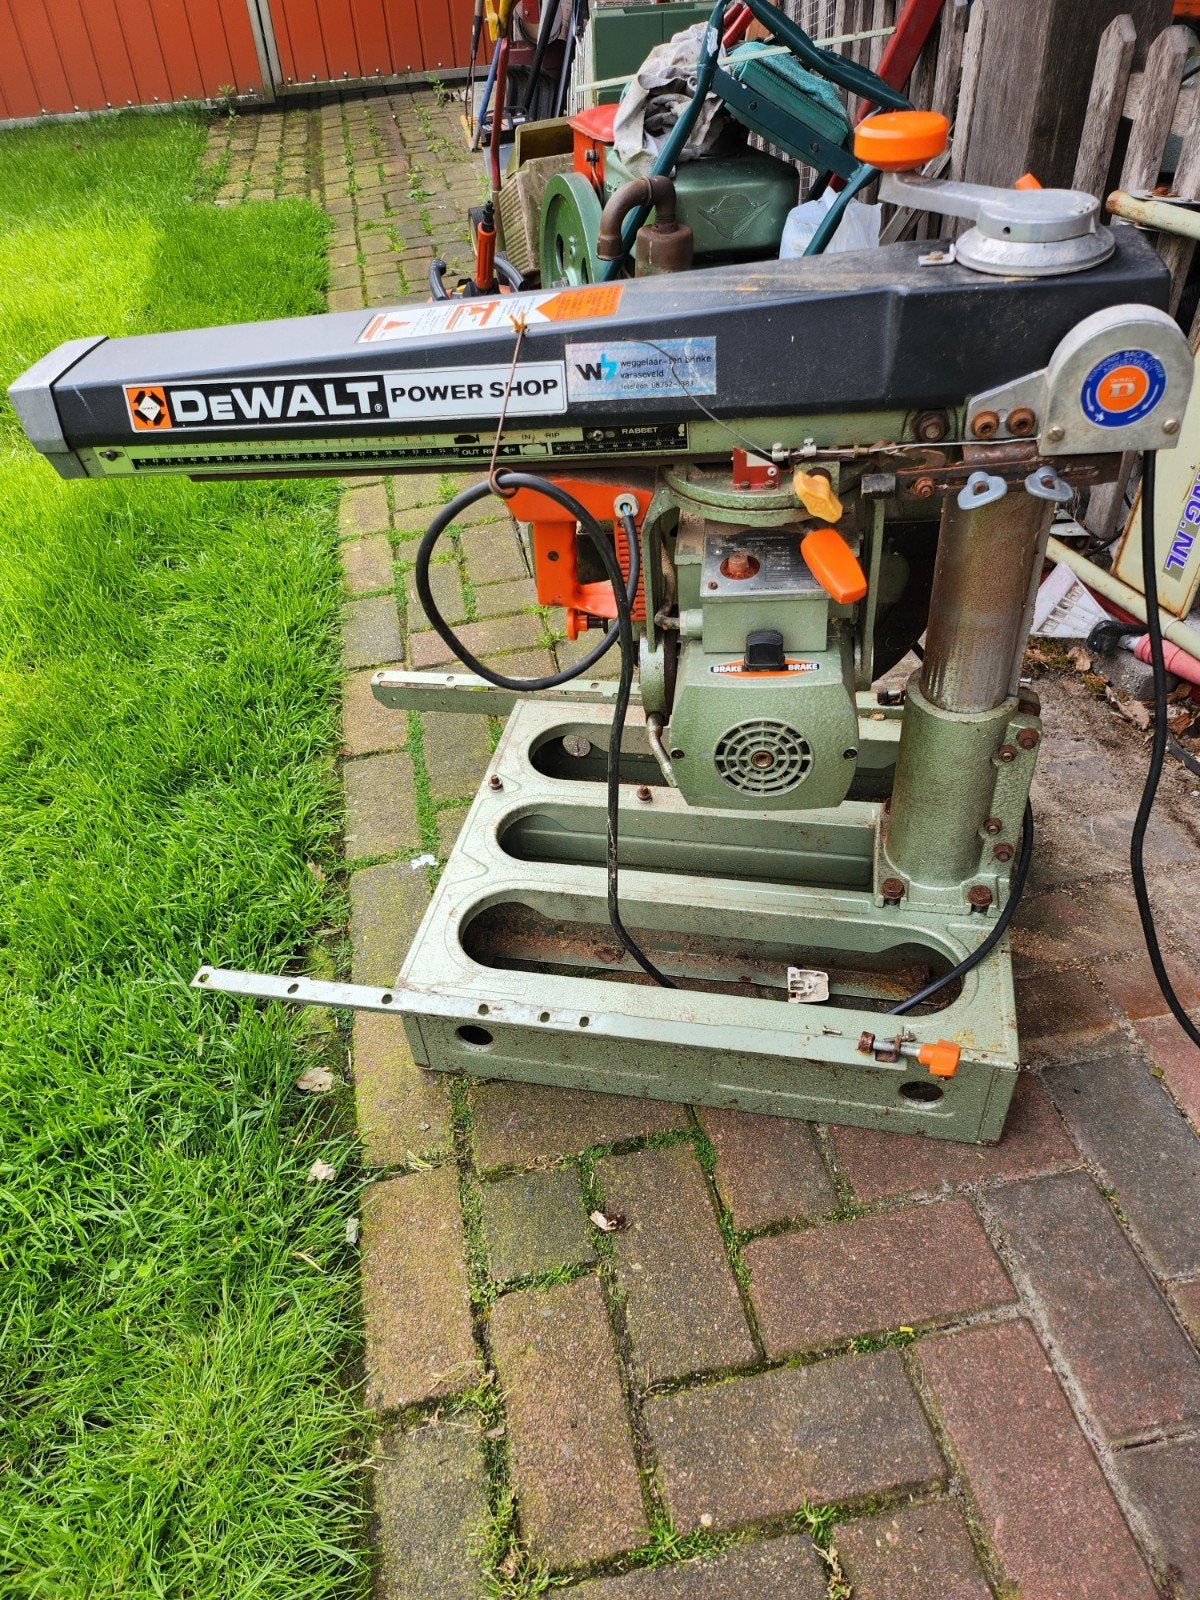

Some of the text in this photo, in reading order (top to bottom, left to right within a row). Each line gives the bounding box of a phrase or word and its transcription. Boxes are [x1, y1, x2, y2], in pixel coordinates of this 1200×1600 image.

[620, 369, 664, 380] varsseveld
[390, 379, 558, 403] POWER SHOP
[713, 665, 743, 673] BRAKE
[787, 663, 818, 671] BRAKE
